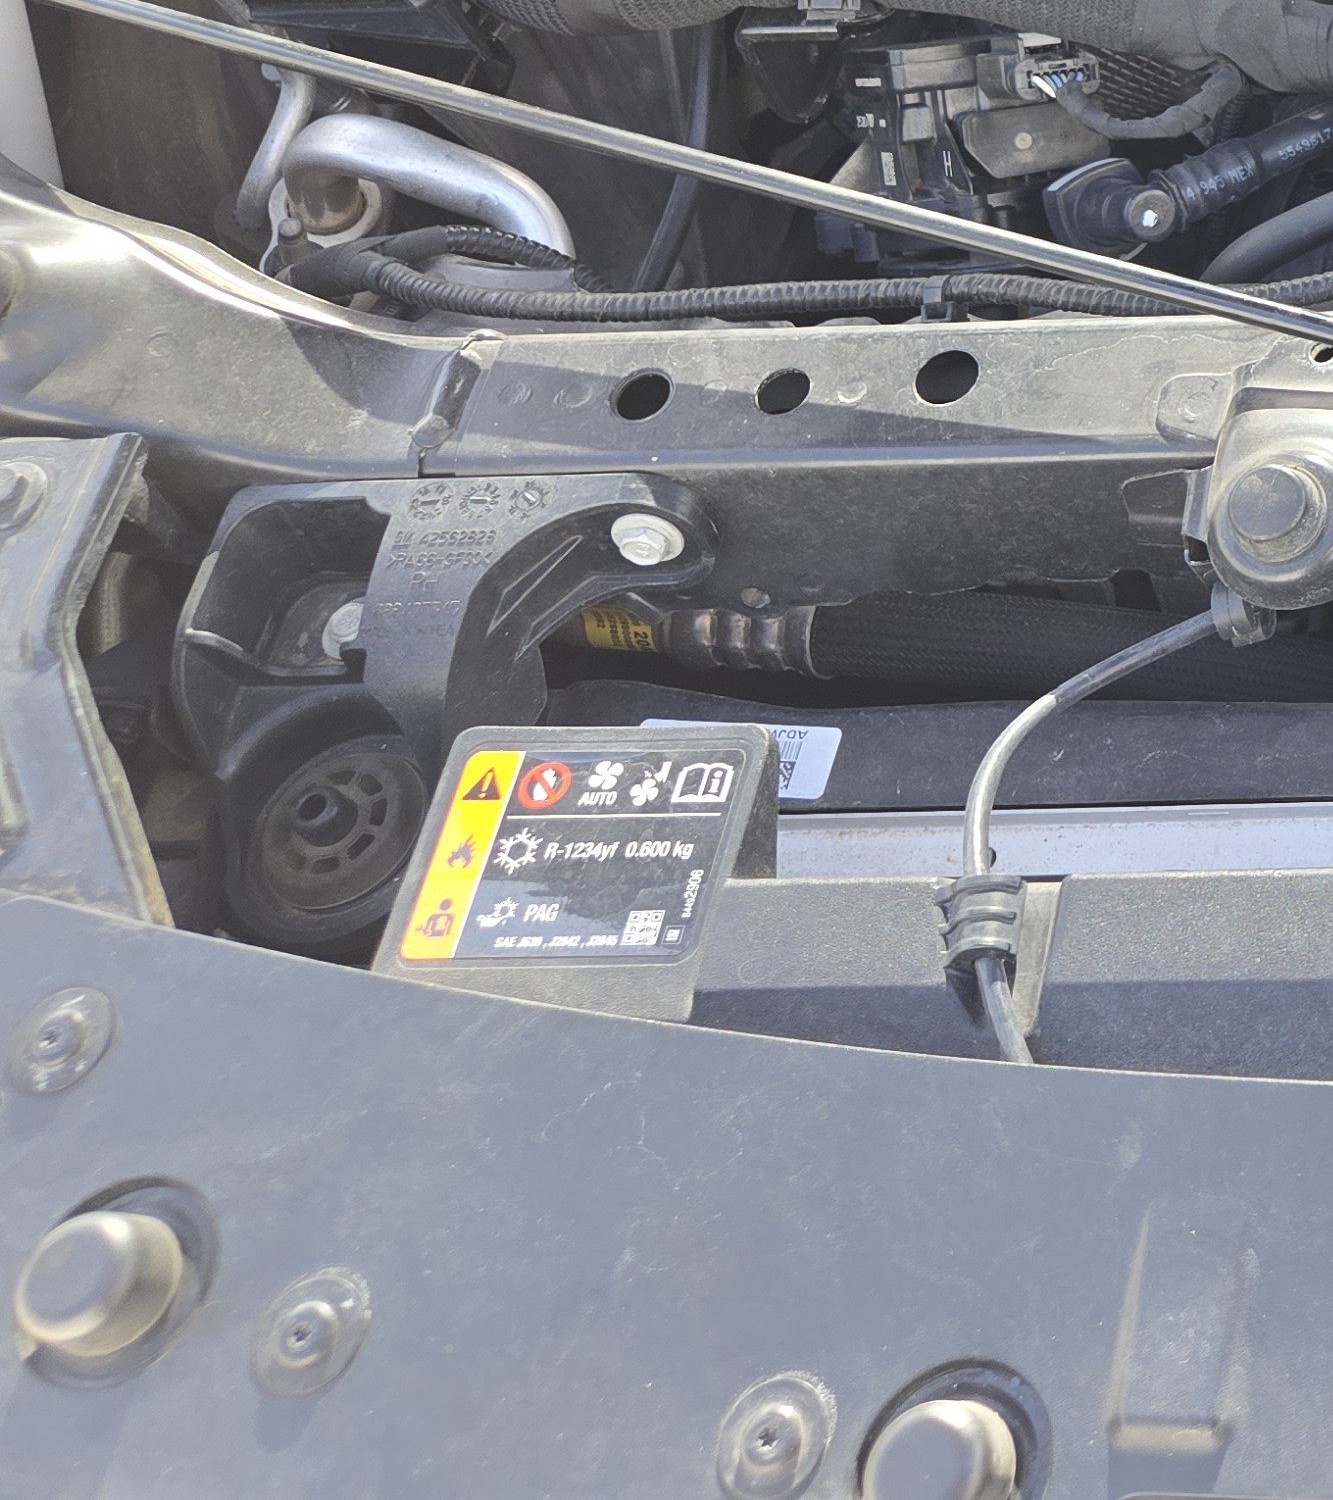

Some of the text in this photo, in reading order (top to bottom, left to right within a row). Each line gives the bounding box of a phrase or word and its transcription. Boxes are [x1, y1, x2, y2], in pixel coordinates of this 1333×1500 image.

[1200, 175, 1226, 194] 945
[577, 791, 618, 806] AUTO
[543, 840, 695, 862] R-1234yf 0.600 kg
[523, 903, 560, 923] PAG
